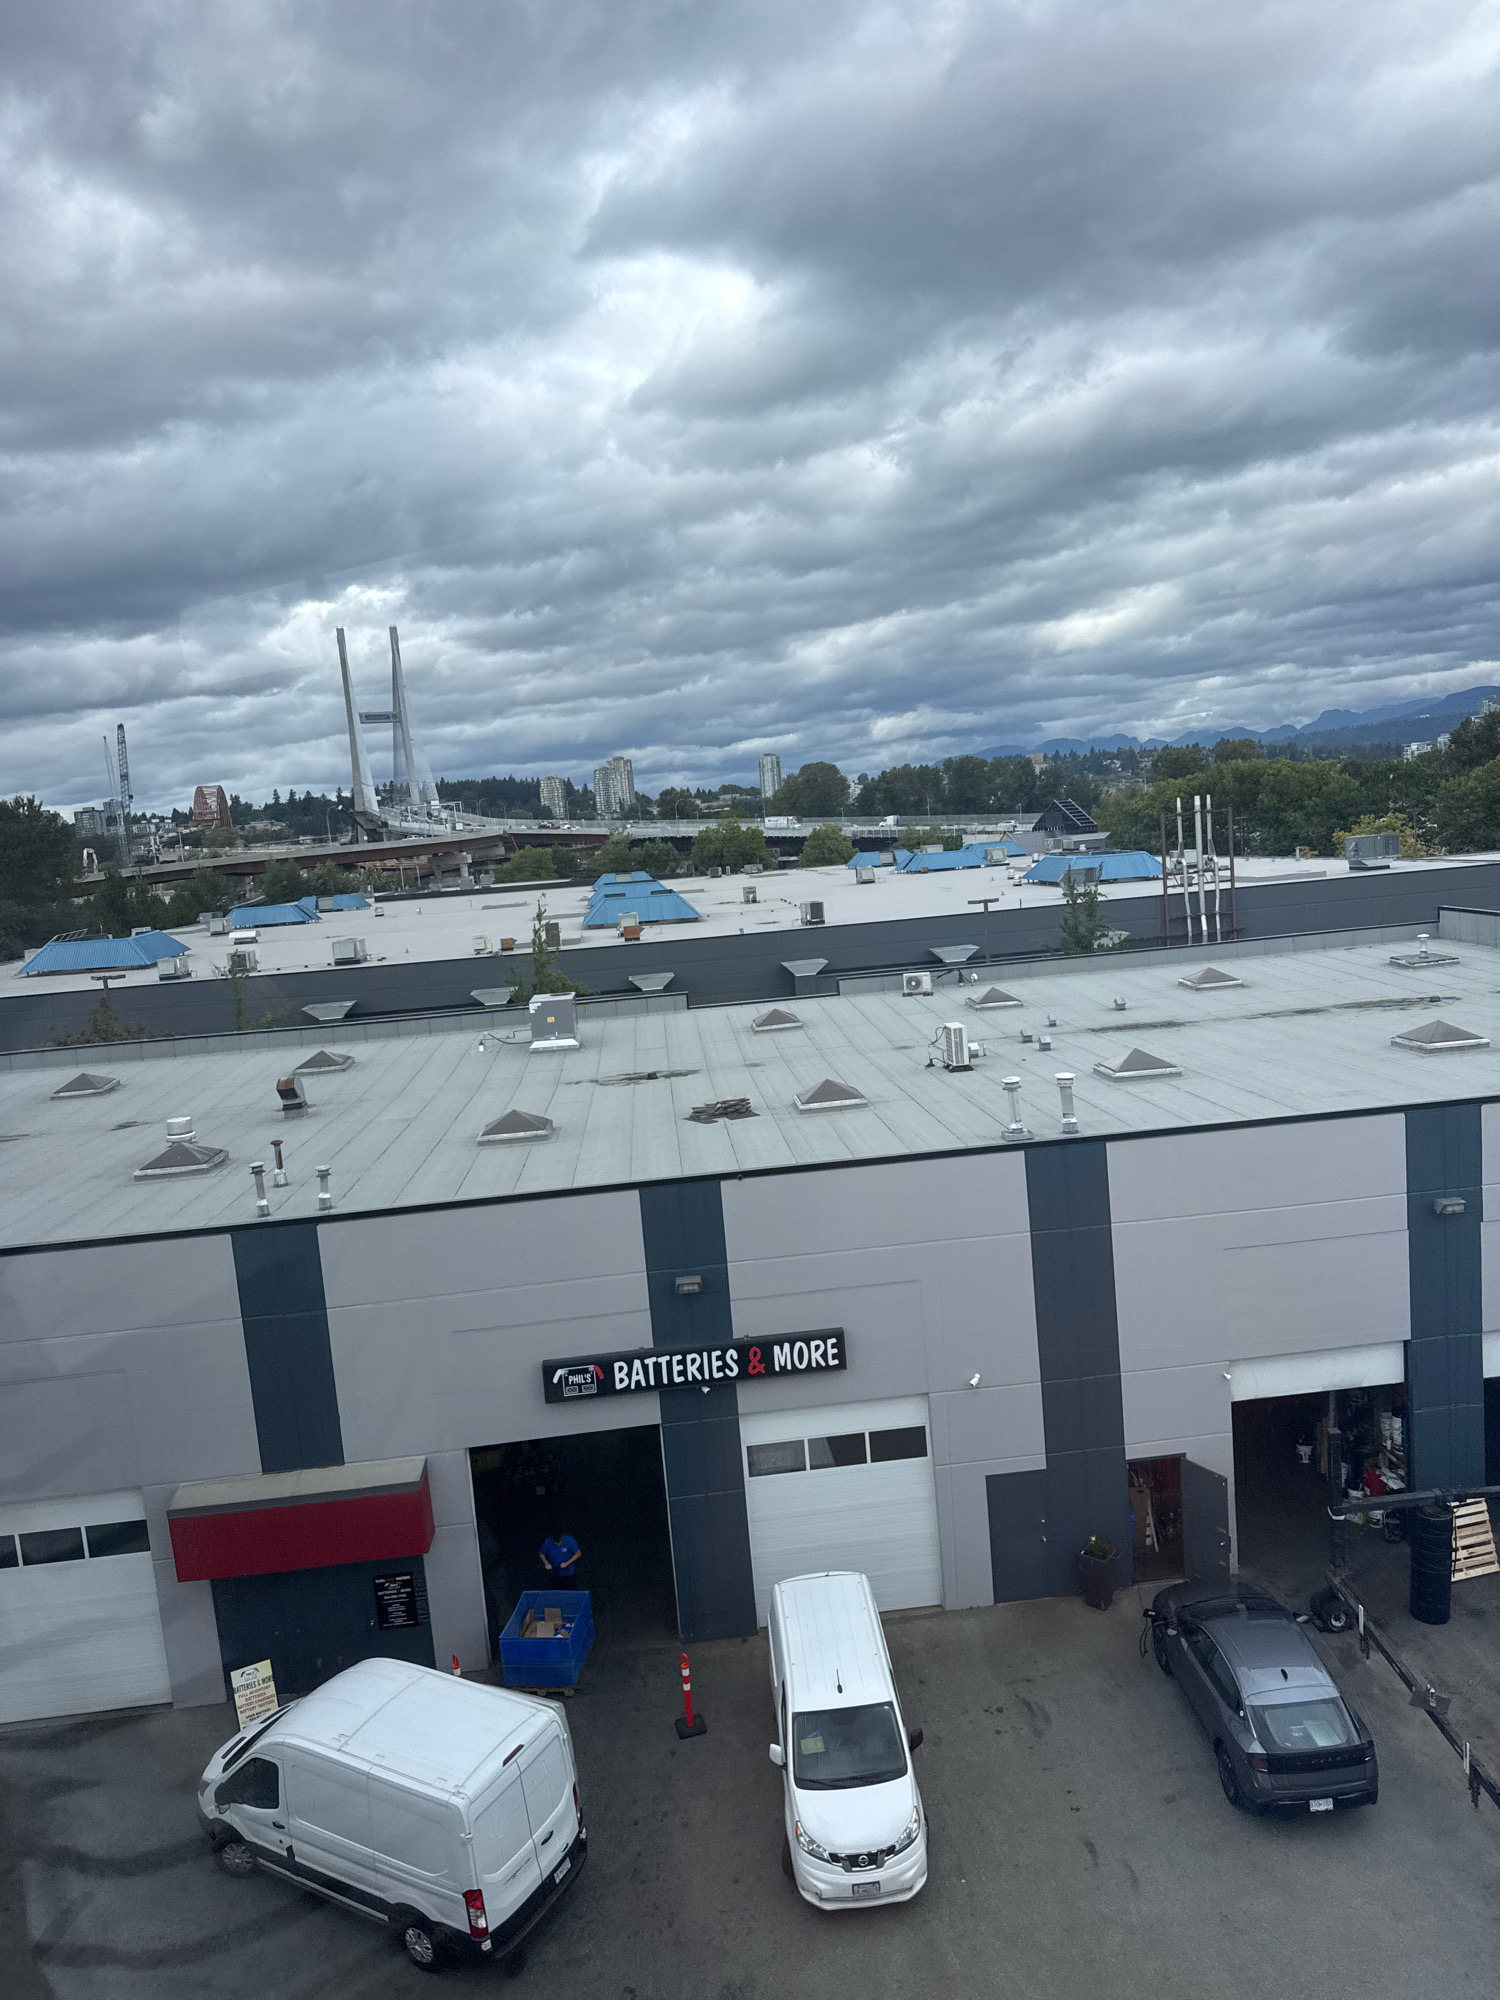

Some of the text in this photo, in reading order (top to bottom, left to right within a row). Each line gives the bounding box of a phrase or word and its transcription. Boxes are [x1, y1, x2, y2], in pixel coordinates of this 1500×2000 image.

[613, 1337, 840, 1390] BATTERIES & MORE
[568, 1373, 592, 1385] PHIL'S
[233, 1681, 256, 1694] BATTERIES
